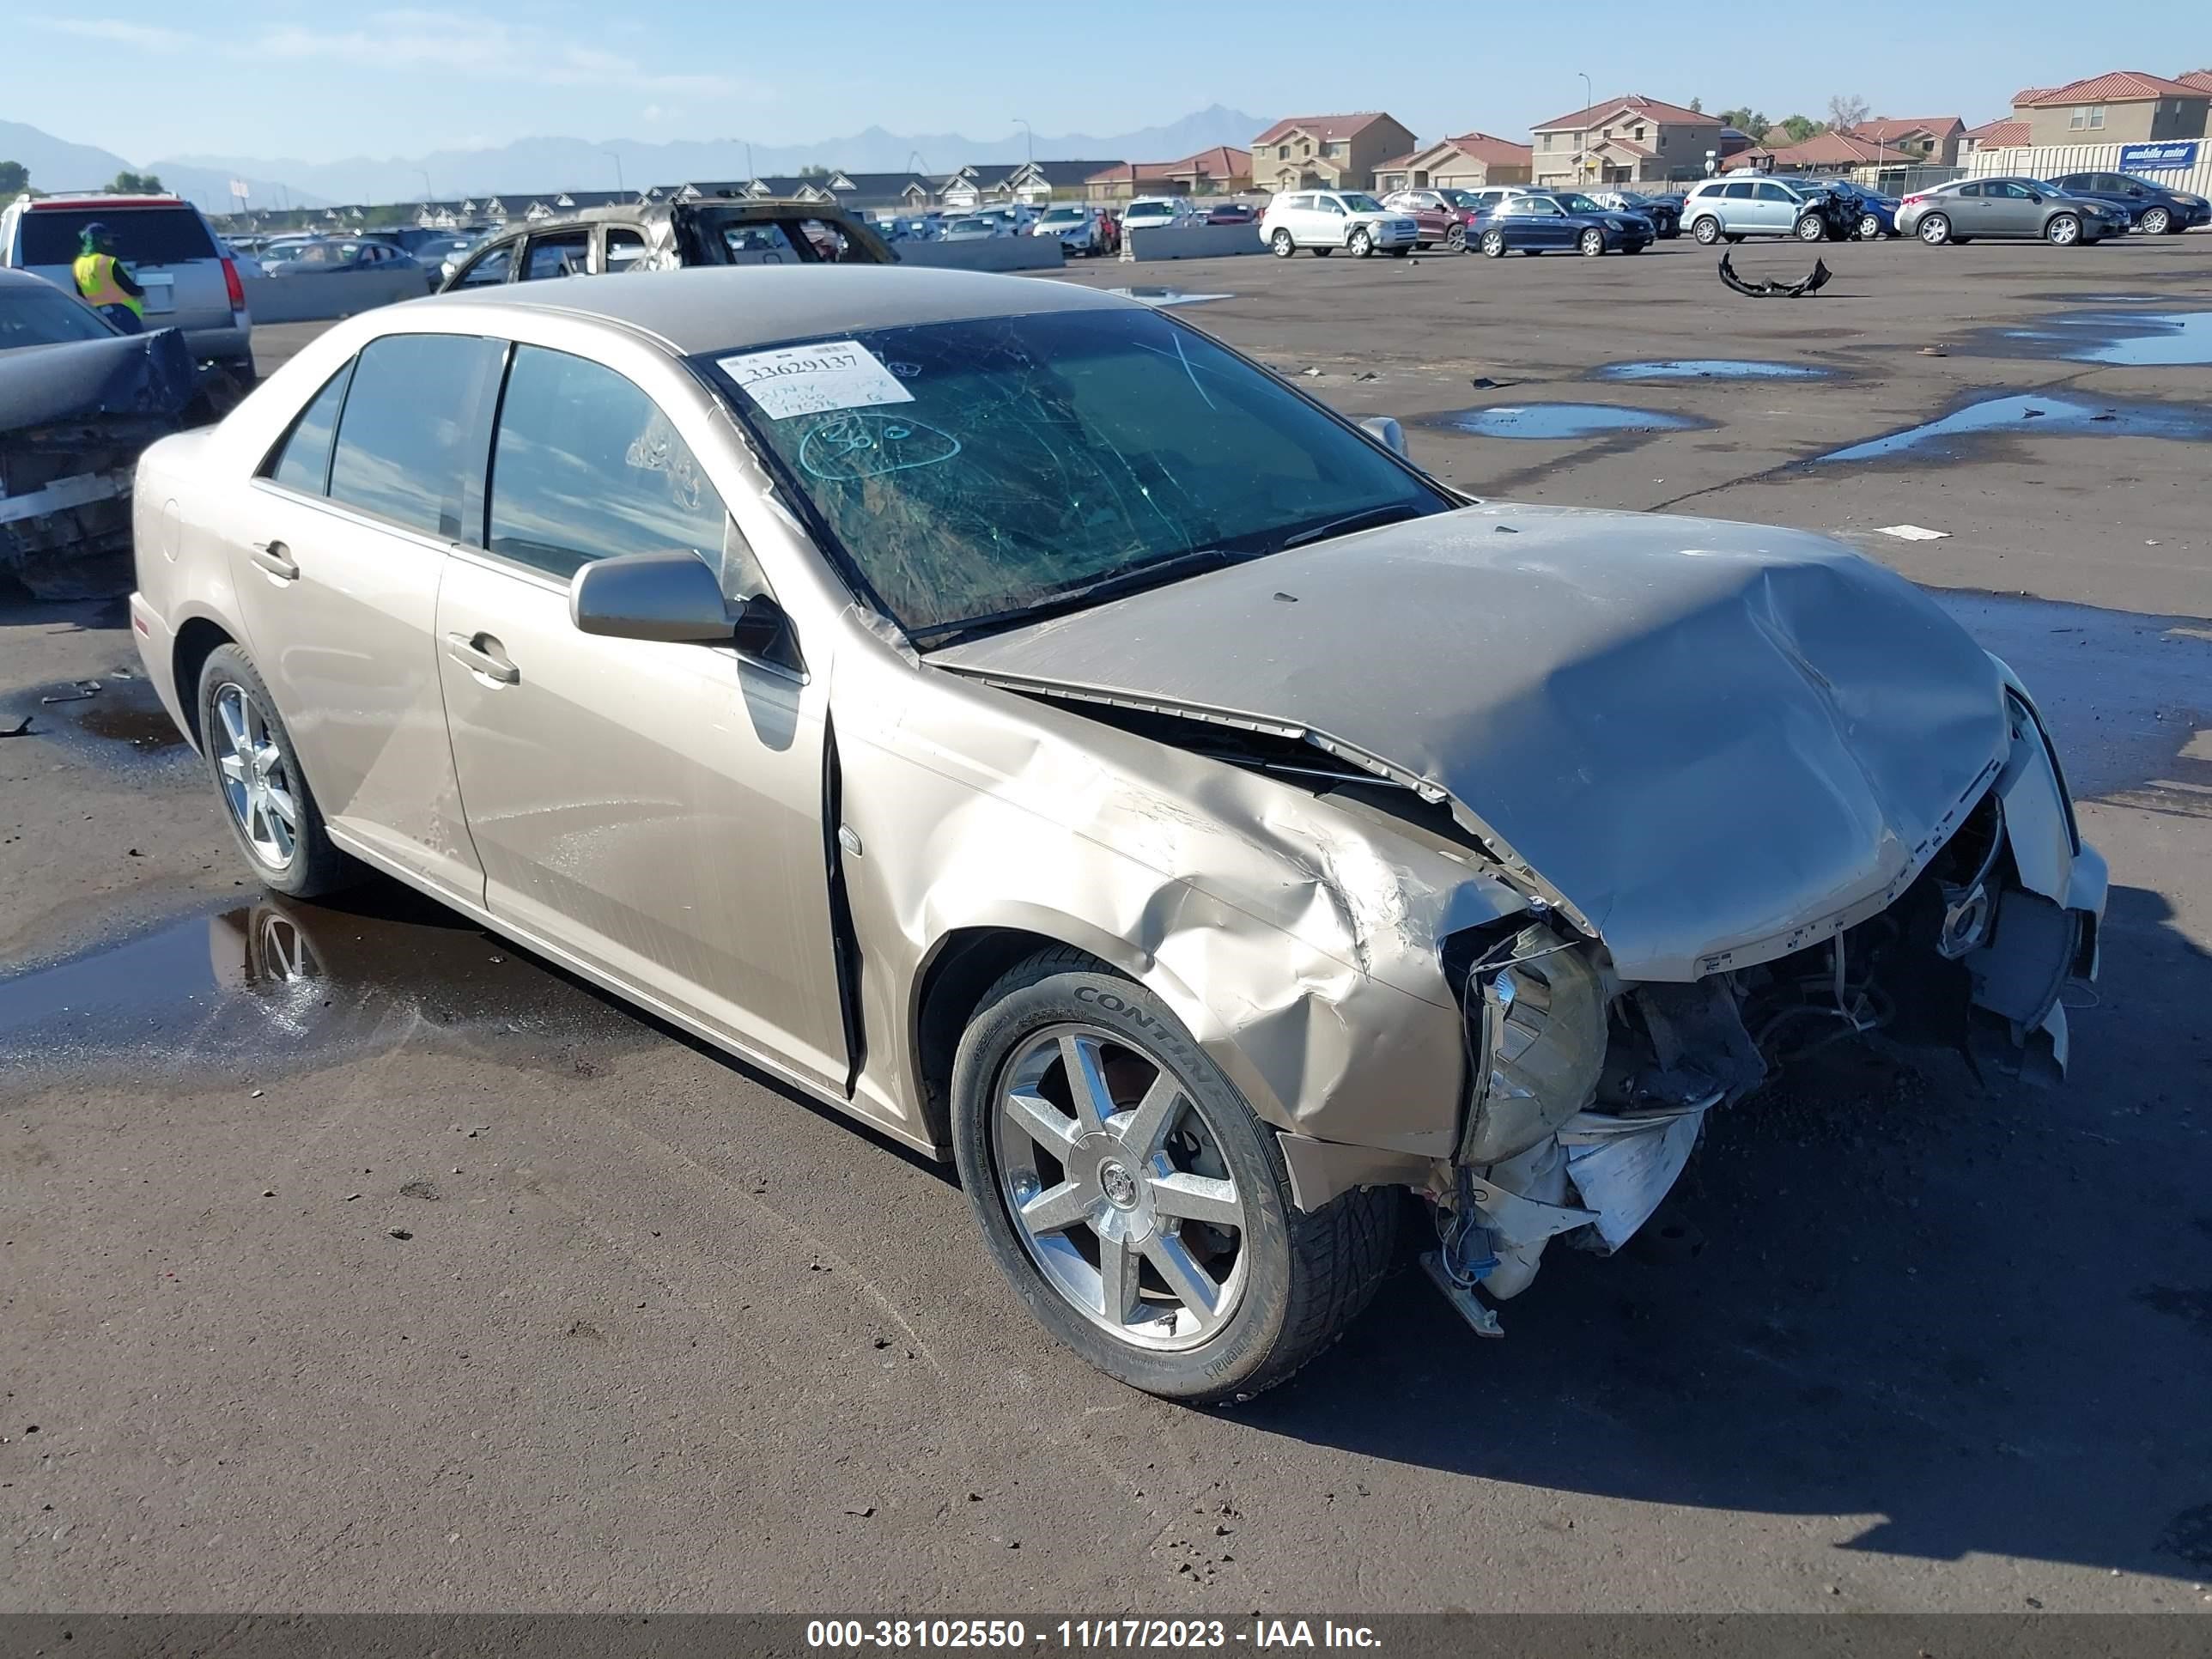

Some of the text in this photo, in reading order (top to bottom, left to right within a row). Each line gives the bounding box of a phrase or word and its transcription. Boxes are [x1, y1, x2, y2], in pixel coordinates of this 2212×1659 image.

[2125, 146, 2191, 160] mobile mini
[746, 355, 857, 380] 33629137
